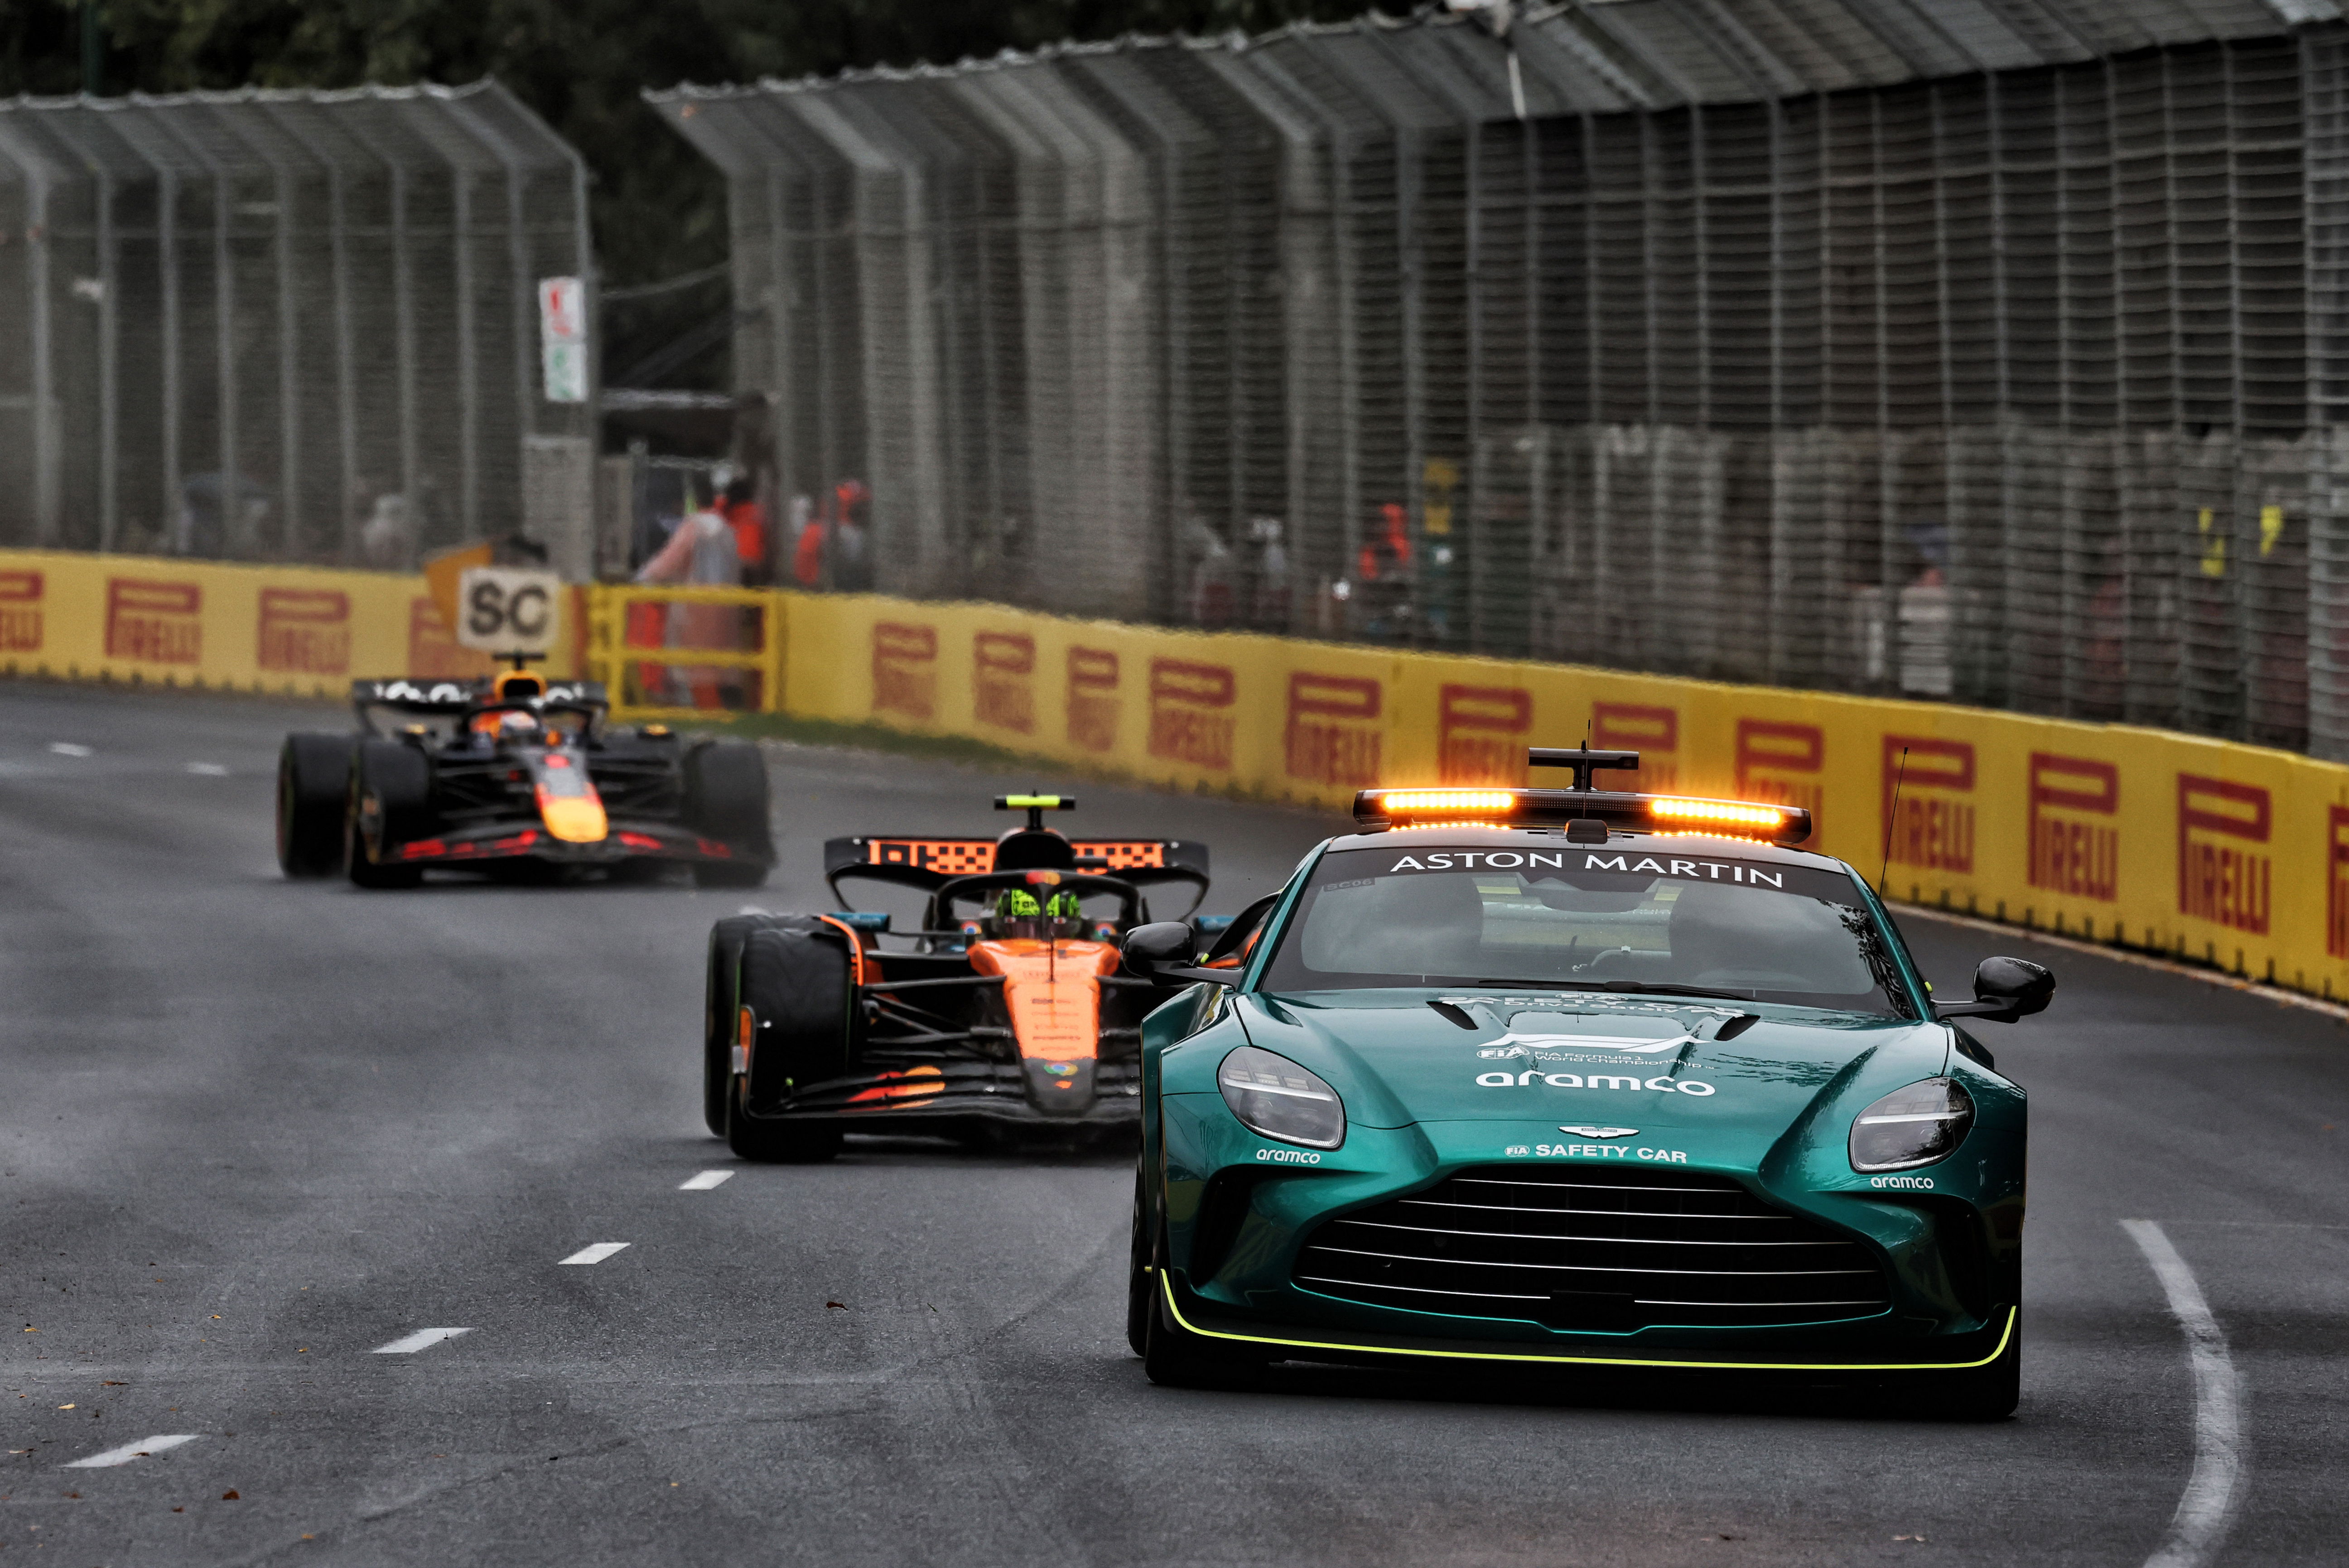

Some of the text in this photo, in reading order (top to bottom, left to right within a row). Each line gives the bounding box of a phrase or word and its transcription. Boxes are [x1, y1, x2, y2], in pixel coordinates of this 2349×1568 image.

[469, 581, 549, 637] SC
[1882, 733, 1975, 873] PIRELLI
[2027, 752, 2119, 902] PIRELLI
[2176, 771, 2271, 937] PIRELLI
[1389, 852, 1783, 888] ASTON MARTIN
[1326, 879, 1372, 891] SC06
[1587, 1057, 1702, 1068] Championship
[1475, 1070, 1716, 1097] aramco
[1256, 1148, 1322, 1164] aramco
[1535, 1144, 1630, 1158] SAFETY
[1636, 1147, 1687, 1164] CAR
[1870, 1177, 1934, 1189] aramco
